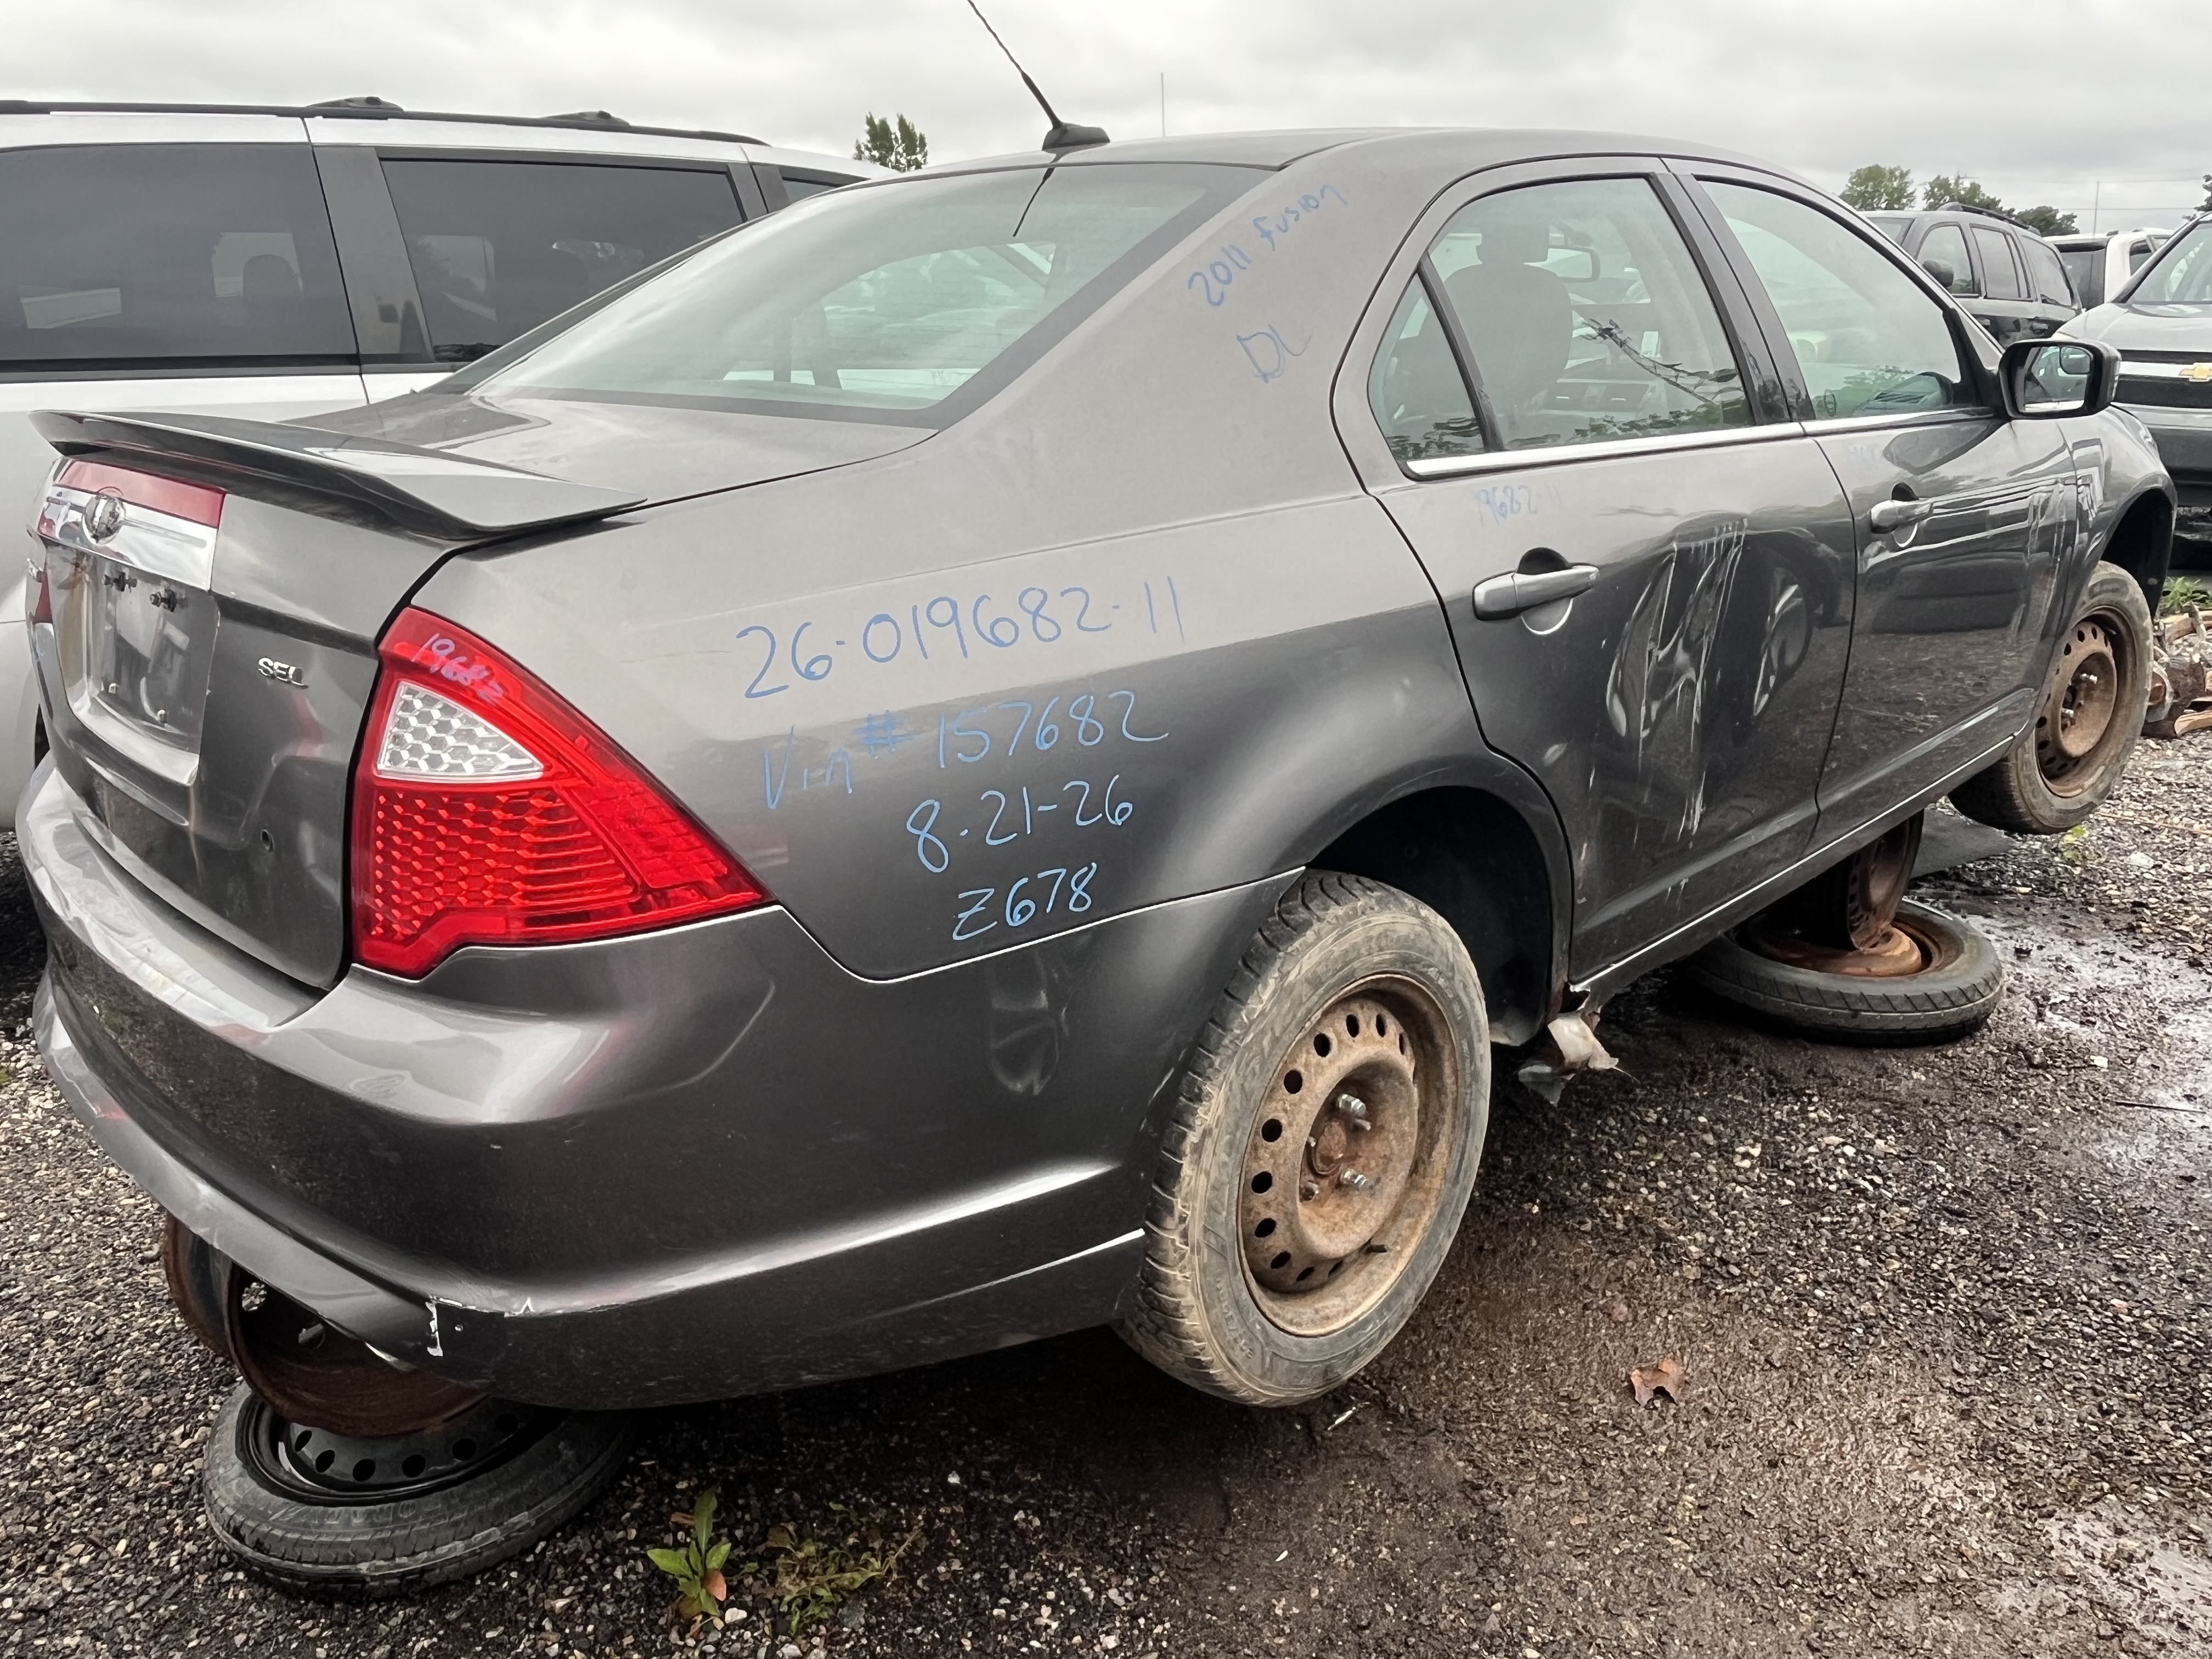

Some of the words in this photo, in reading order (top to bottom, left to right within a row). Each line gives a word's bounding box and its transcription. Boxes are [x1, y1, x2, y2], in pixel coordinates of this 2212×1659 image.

[1188, 245, 1252, 306] 2011
[257, 657, 307, 688] SEL
[938, 690, 1170, 769] 157682
